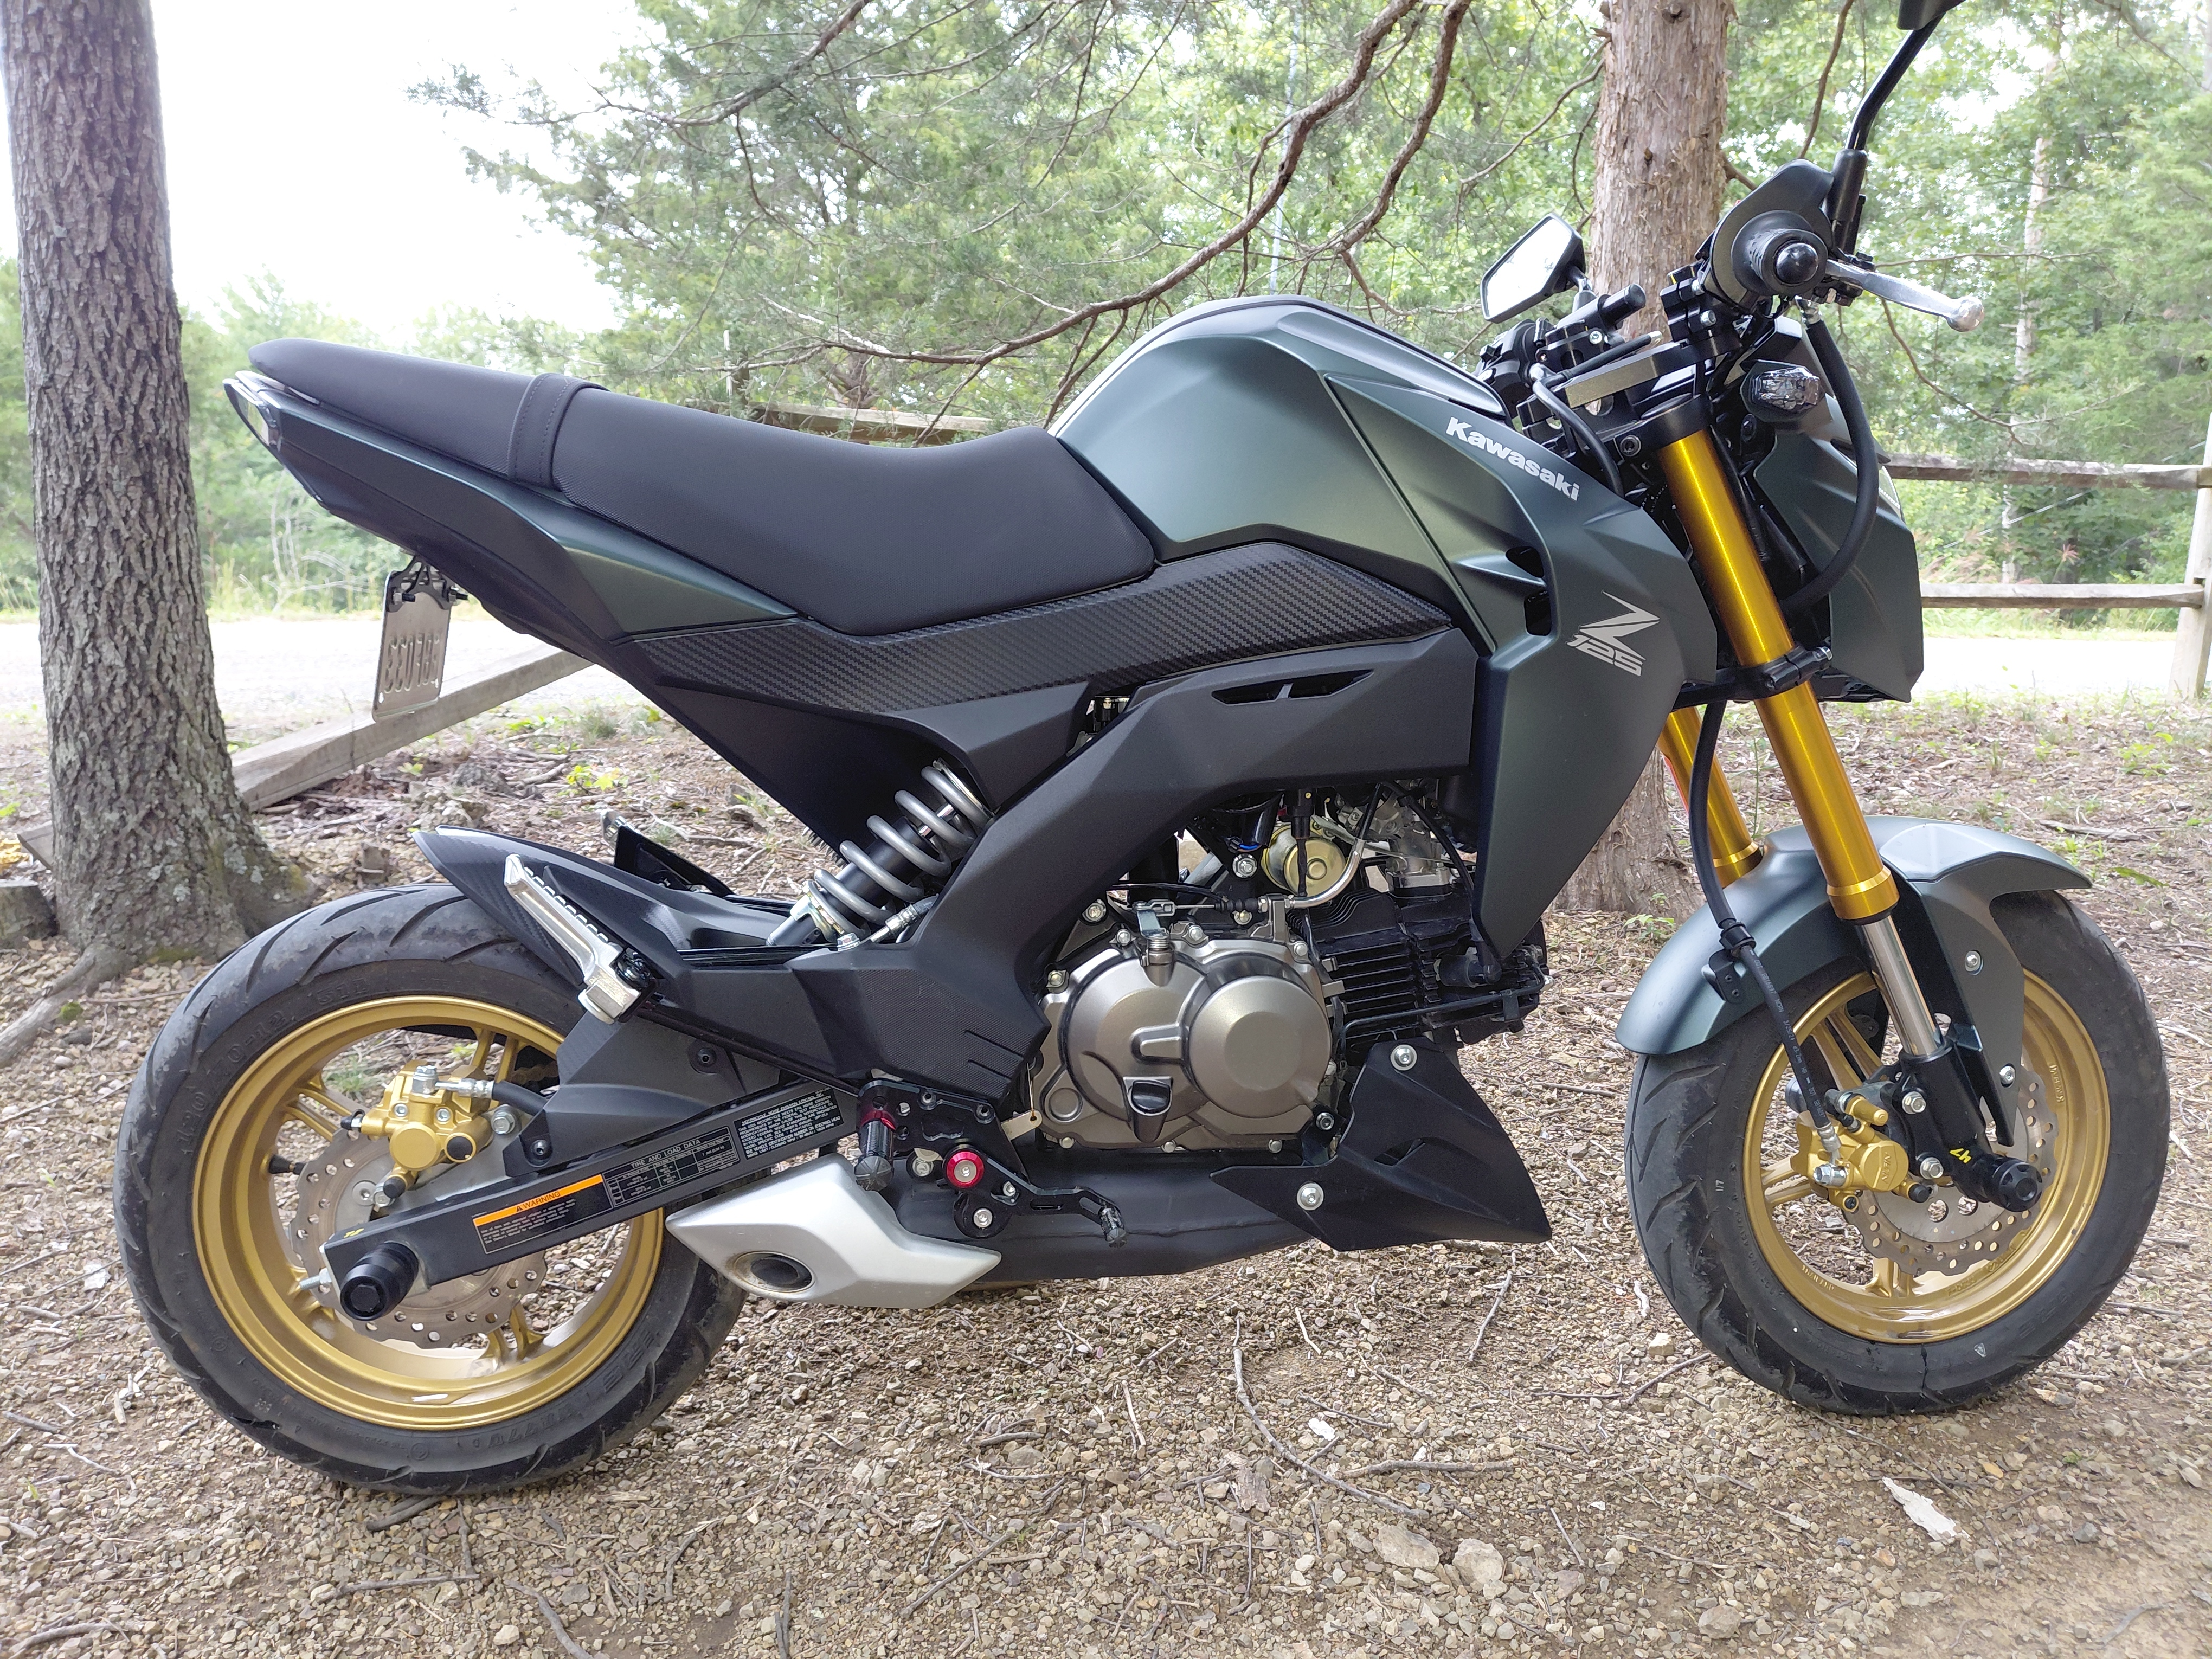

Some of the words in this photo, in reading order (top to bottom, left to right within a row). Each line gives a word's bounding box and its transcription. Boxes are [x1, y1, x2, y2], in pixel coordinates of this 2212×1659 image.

[1446, 416, 1580, 501] Kawasaki
[1566, 633, 1643, 677] 125
[1753, 959, 1763, 969] DOT
[173, 1009, 292, 1147] 12070-12
[739, 1123, 767, 1135] REQUIREMENTS
[782, 1111, 798, 1120] FEDERAL
[740, 1127, 767, 1139] MODIFICATIONS
[803, 1104, 827, 1115] MOTORCYCLE
[756, 1114, 780, 1124] MOTORCYCLE
[814, 1095, 831, 1103] EMISSION
[741, 1134, 756, 1142] EXCEED
[756, 1128, 773, 1136] FEDERAL
[786, 1116, 807, 1126] STANDARDS
[748, 1136, 763, 1144] FEDERAL
[753, 1143, 767, 1151] VEHICLE
[768, 1133, 793, 1146] IDENTIFICATION
[793, 1128, 808, 1136] NUMBER
[814, 1119, 831, 1128] STEERING
[757, 1136, 773, 1144] SPECIFIC
[630, 1159, 645, 1169] TIRE
[647, 1153, 662, 1162] AND
[663, 1146, 681, 1156] LOAD
[683, 1139, 701, 1149] DATA
[770, 1140, 786, 1149] CLOSING
[523, 1191, 561, 1205] WARNING
